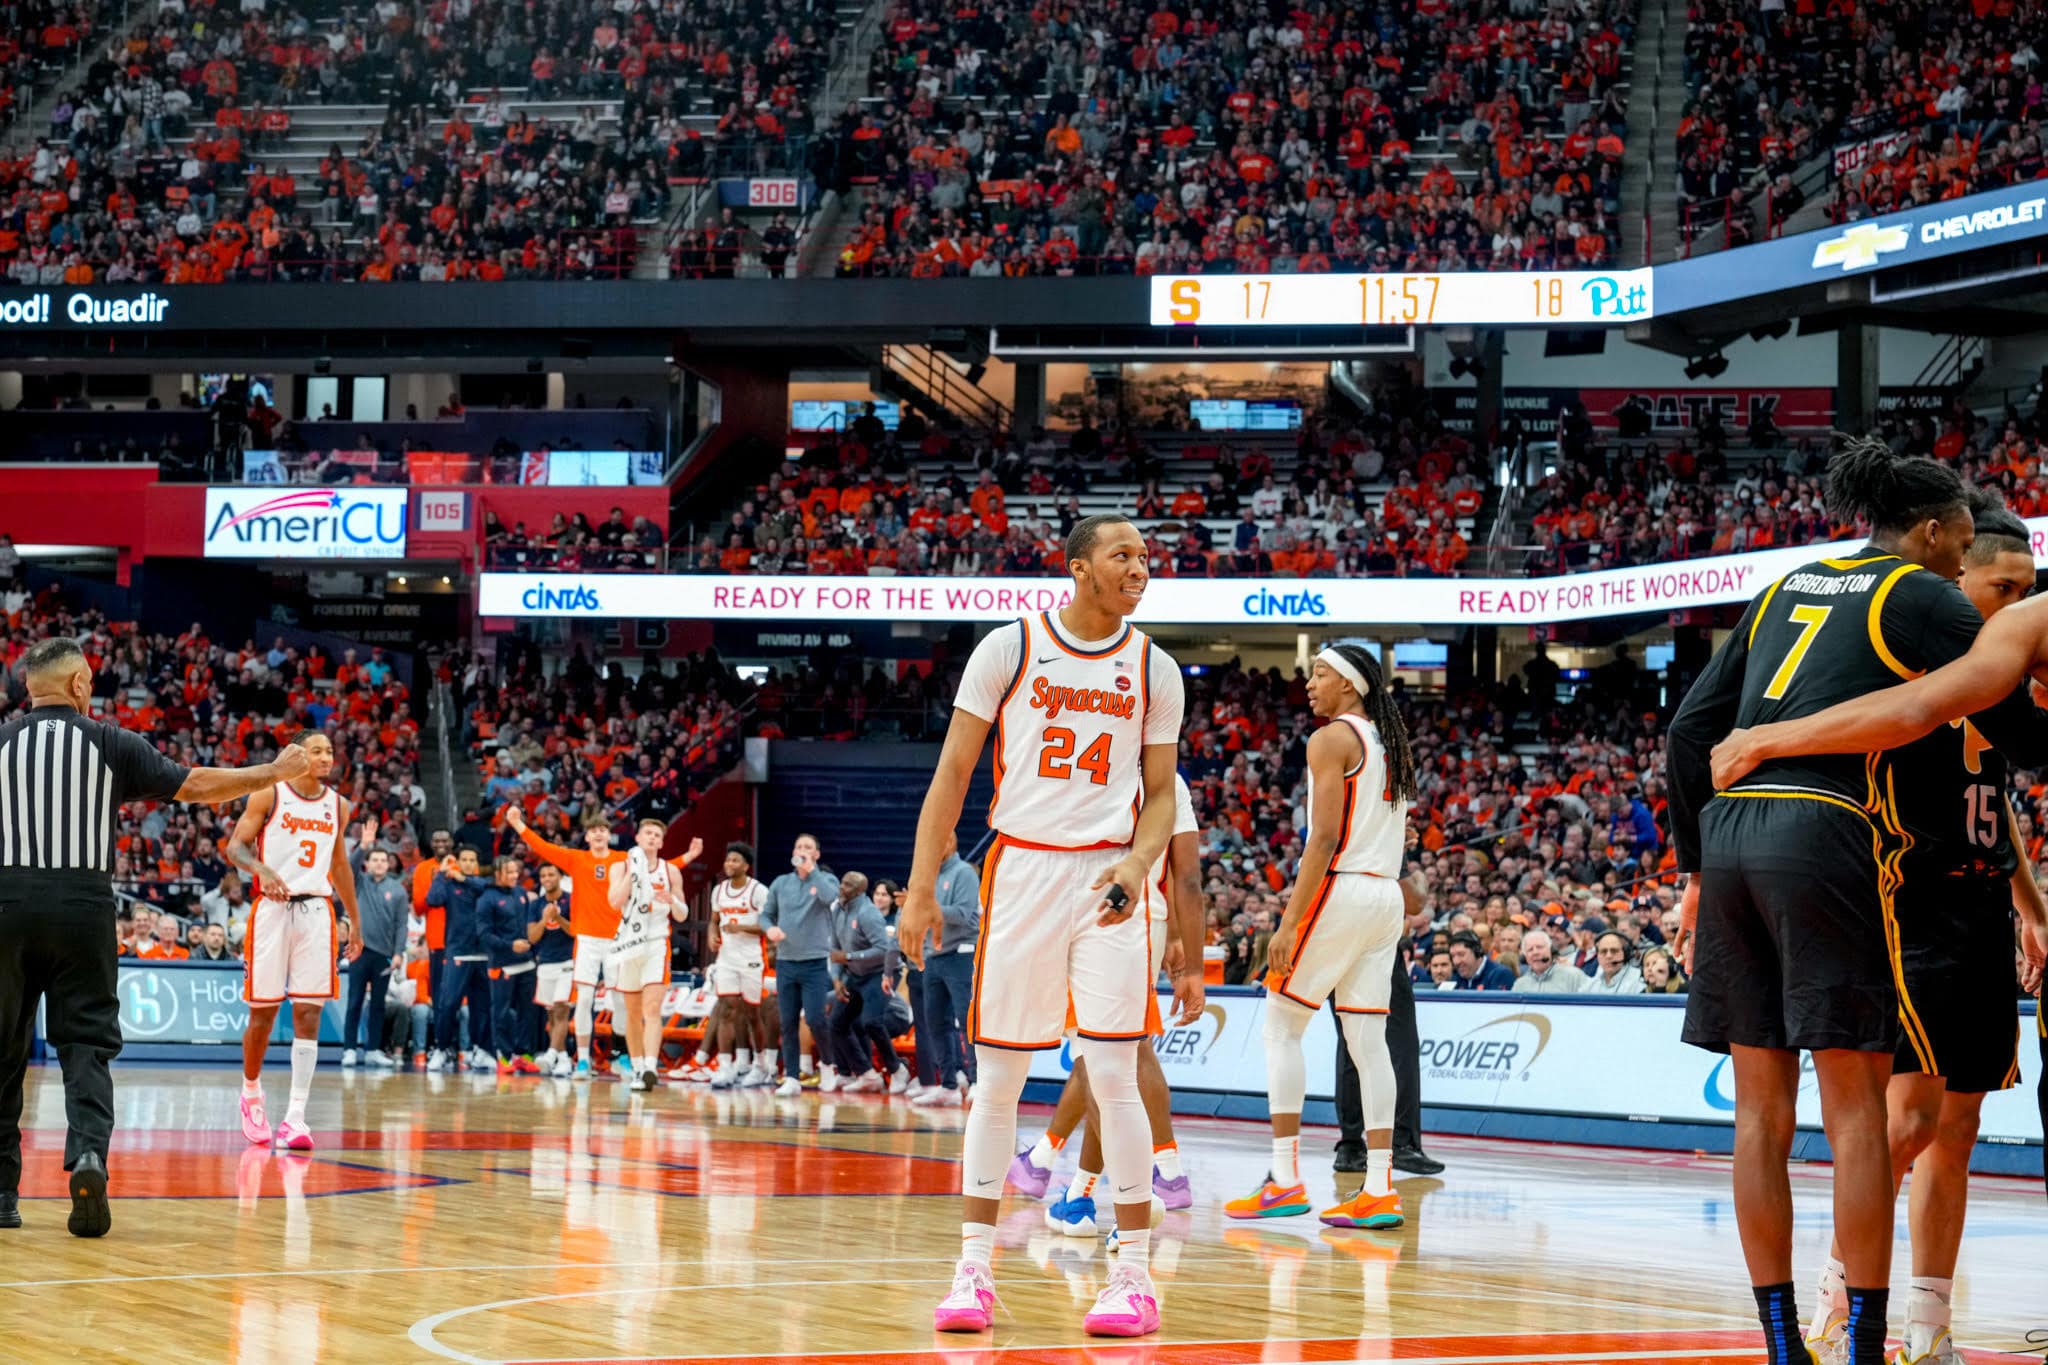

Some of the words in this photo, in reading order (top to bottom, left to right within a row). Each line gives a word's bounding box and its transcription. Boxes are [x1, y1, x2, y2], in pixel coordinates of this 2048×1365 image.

[751, 183, 796, 204] 306
[1921, 198, 2046, 243] CHEVROLET
[0, 293, 50, 323] od!
[67, 293, 169, 323] Quadir
[1169, 279, 1201, 322] S
[1243, 281, 1272, 319] 17
[1358, 276, 1440, 324] 11:57
[1533, 278, 1563, 317] 18
[207, 501, 407, 543] AmeriCU
[424, 503, 460, 520] 105
[714, 586, 805, 608] READY
[817, 587, 871, 609] FOR
[882, 588, 933, 610] THE
[946, 589, 1072, 611] WORKDA
[1459, 589, 1550, 613] READY
[1557, 585, 1594, 610] FOR
[1601, 578, 1636, 606] THE
[1783, 573, 1877, 595] CARRINGTON
[1763, 604, 1833, 700] 7
[1030, 676, 1136, 720] Syracuse
[1038, 726, 1113, 786] 24
[281, 812, 334, 835] Syracuse
[1963, 783, 1998, 849] 15
[298, 839, 317, 868] 3
[1419, 1040, 1519, 1070] POWER
